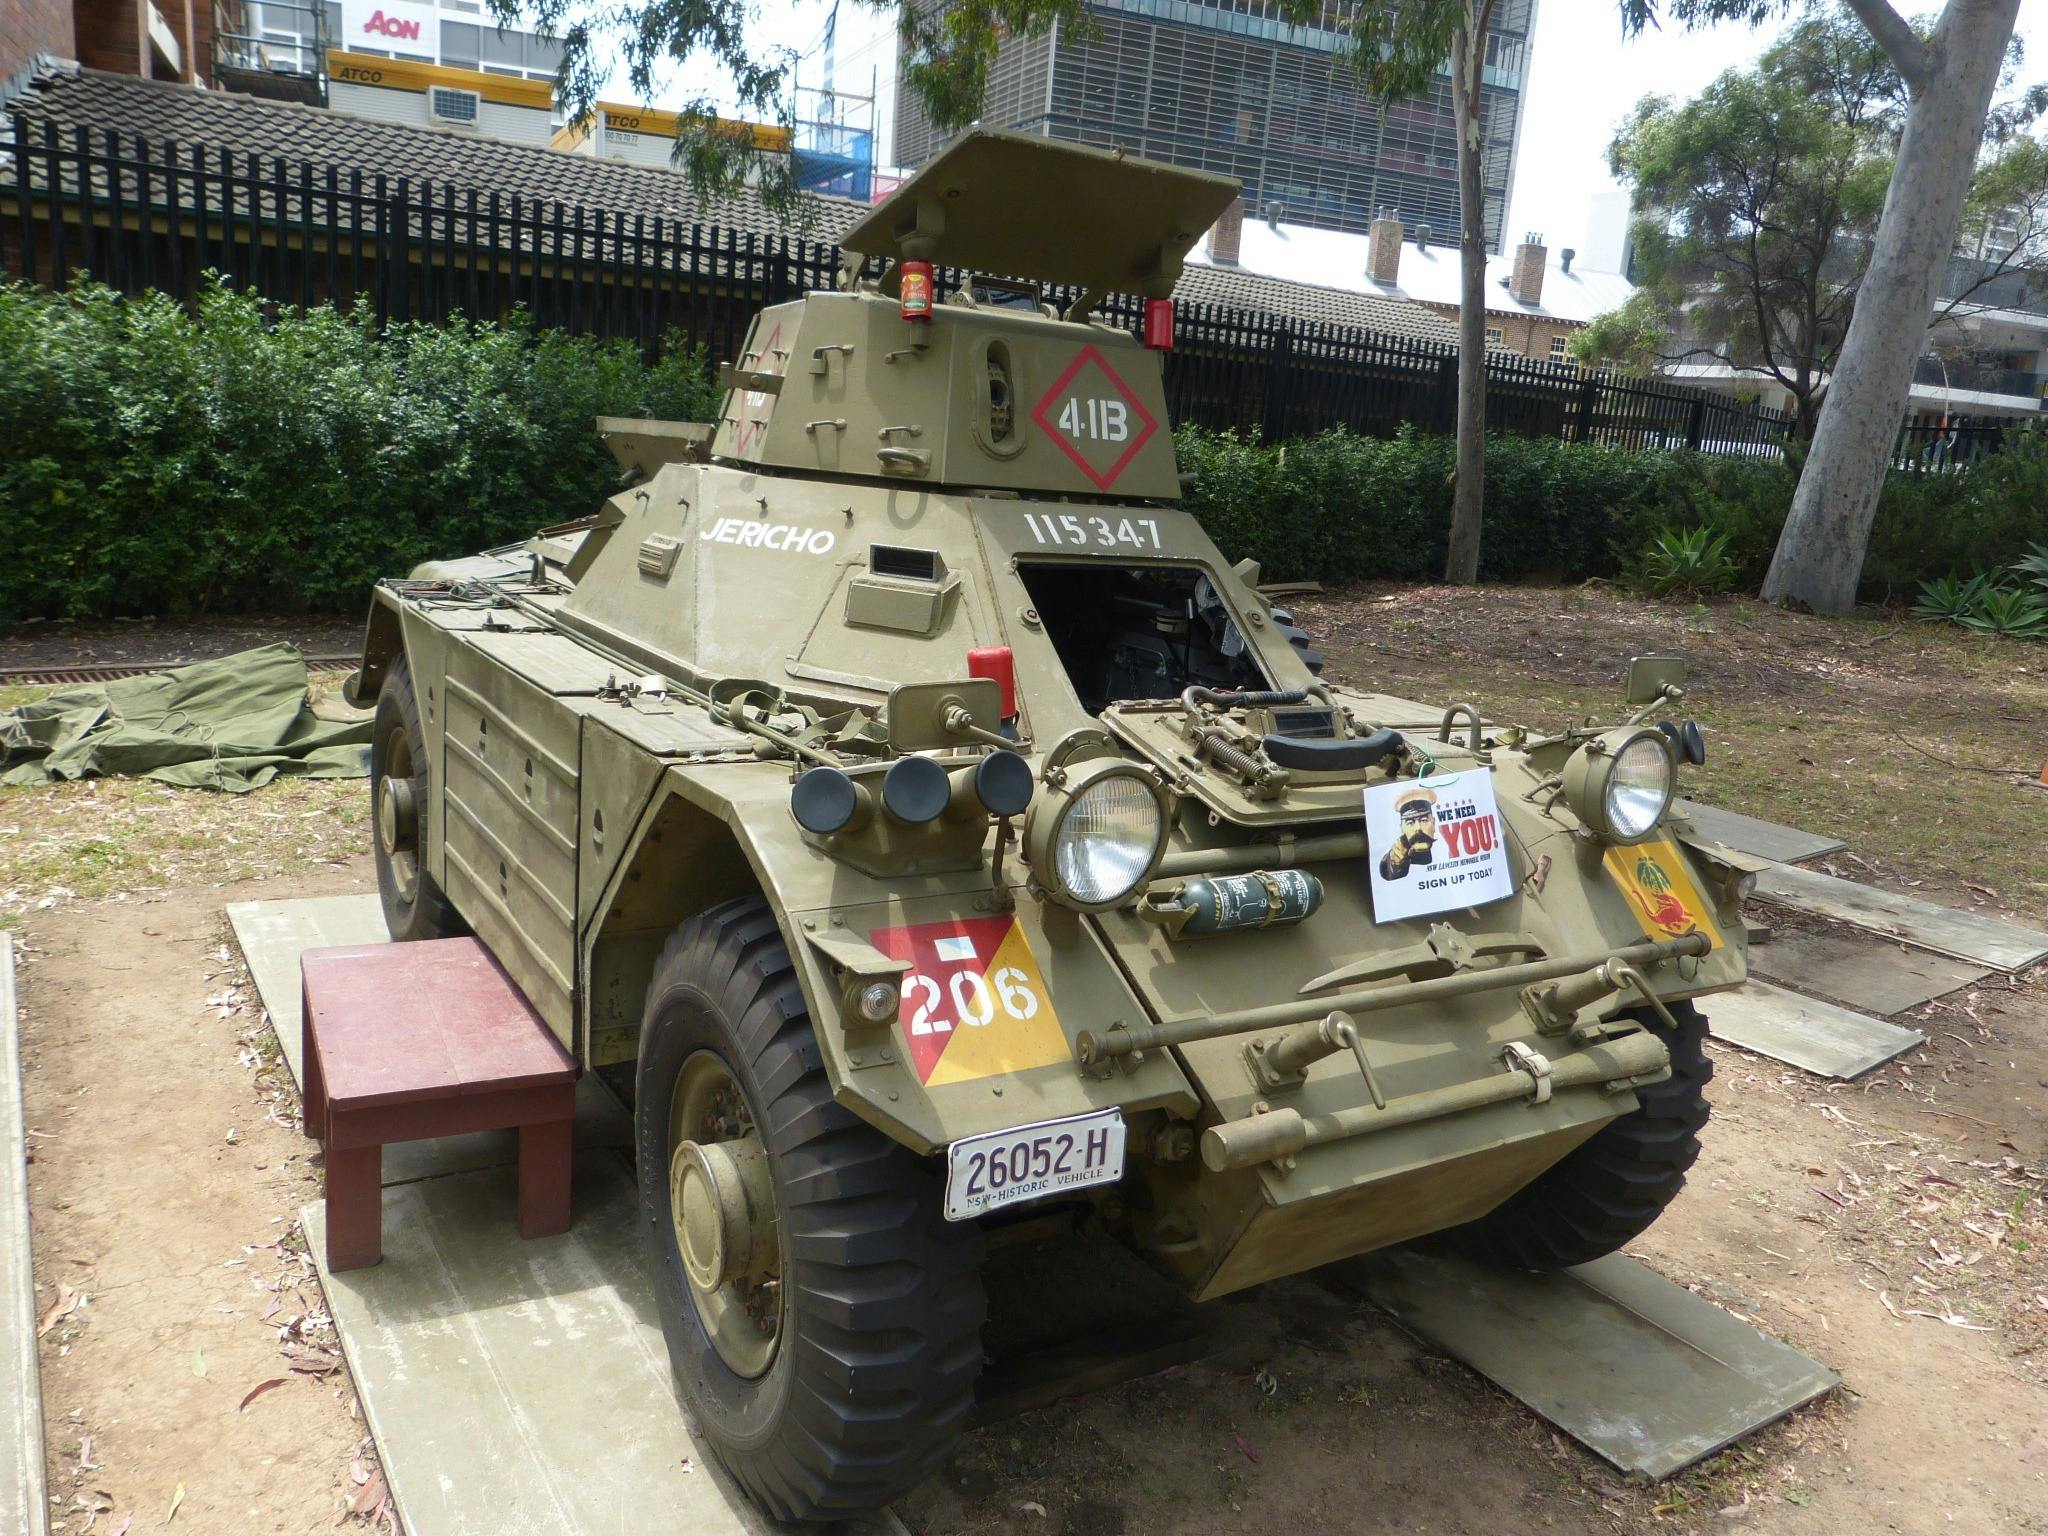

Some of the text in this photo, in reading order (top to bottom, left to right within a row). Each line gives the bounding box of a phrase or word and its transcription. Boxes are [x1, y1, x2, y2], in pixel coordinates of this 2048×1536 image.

[340, 67, 382, 82] ATCO
[700, 517, 835, 555] JERICHO
[1024, 513, 1160, 549] 115347
[1437, 805, 1476, 822] WE NEED
[1438, 814, 1498, 859] YOU!
[1418, 867, 1493, 890] SIGN UP TODAY
[901, 967, 1038, 1036] 206
[1057, 1169, 1104, 1185] VEHICLE
